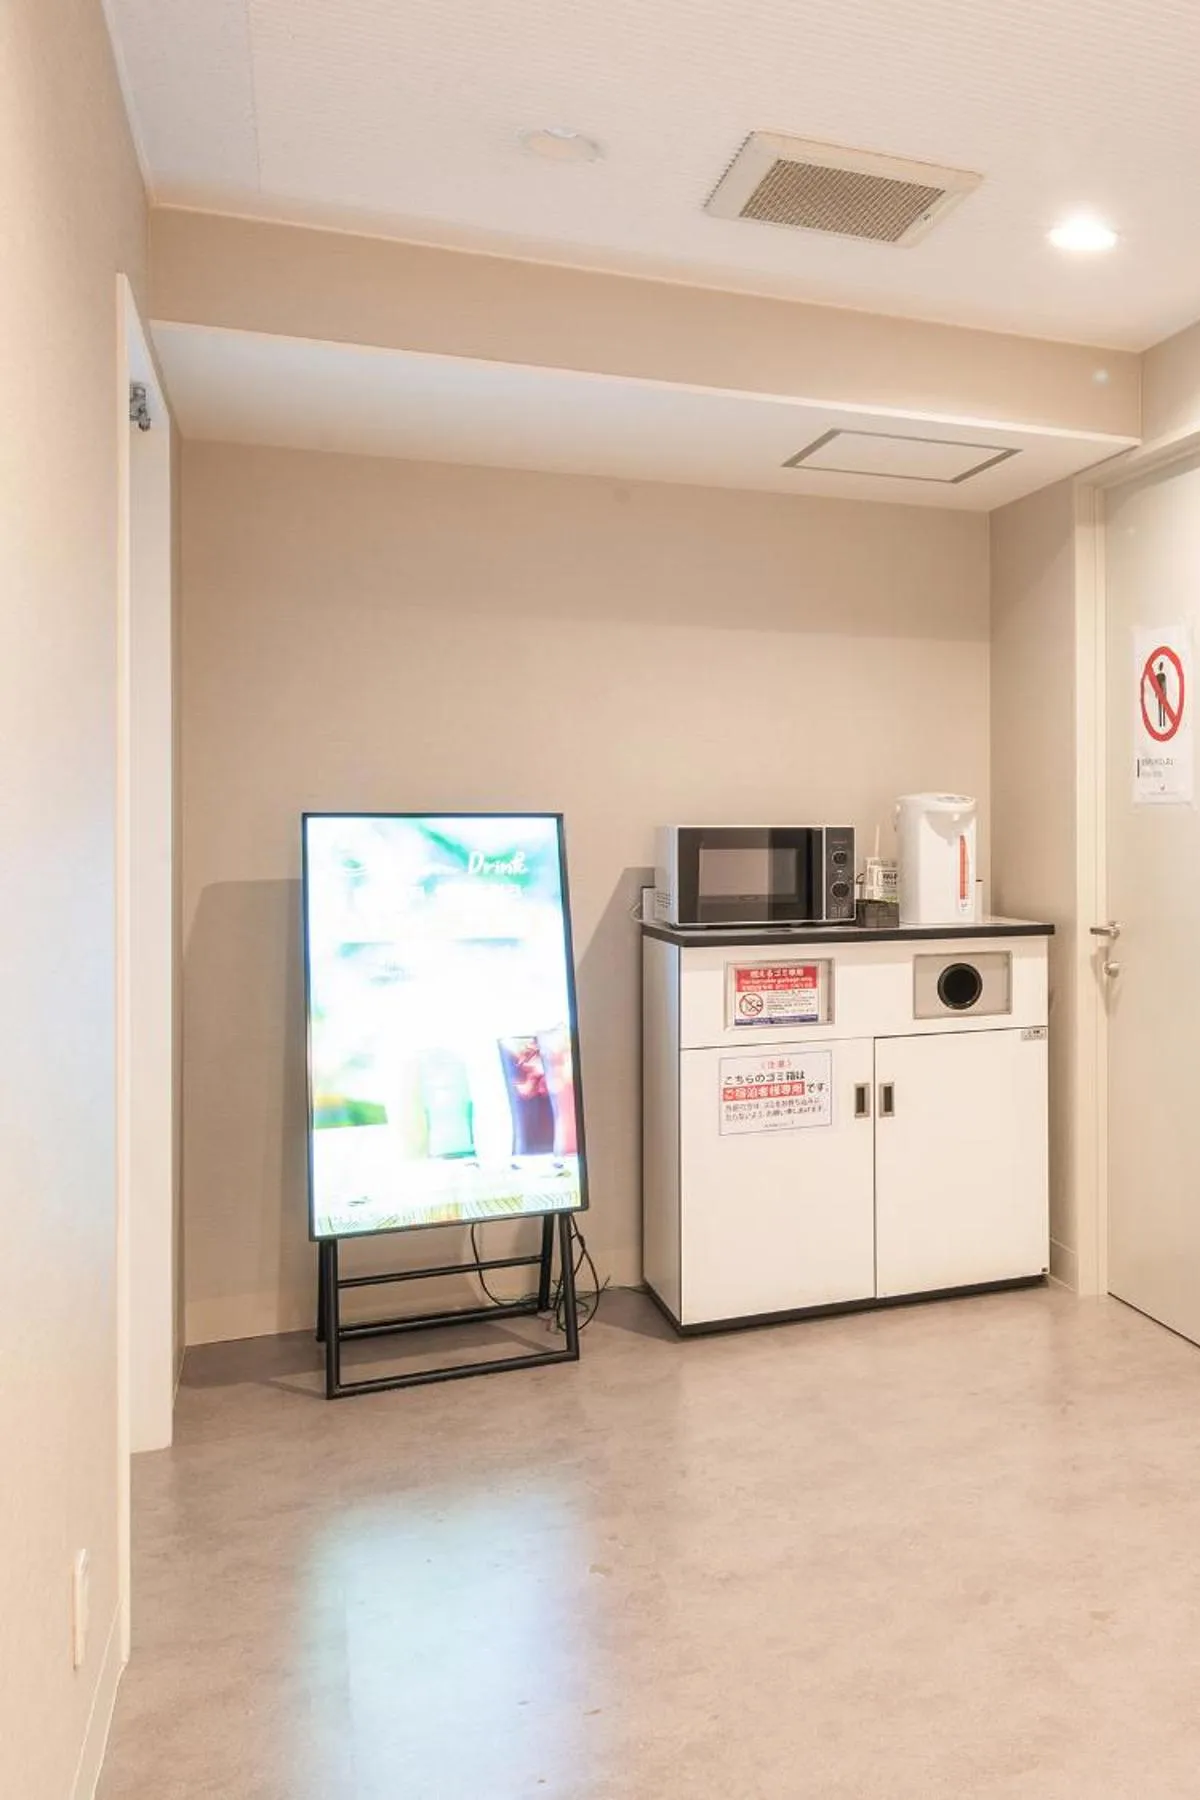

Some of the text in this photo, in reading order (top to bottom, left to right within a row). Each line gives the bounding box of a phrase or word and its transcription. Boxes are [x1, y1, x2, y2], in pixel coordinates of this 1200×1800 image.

[468, 850, 530, 875] Drink
[724, 1070, 806, 1085] こちらのゴミ箱は
